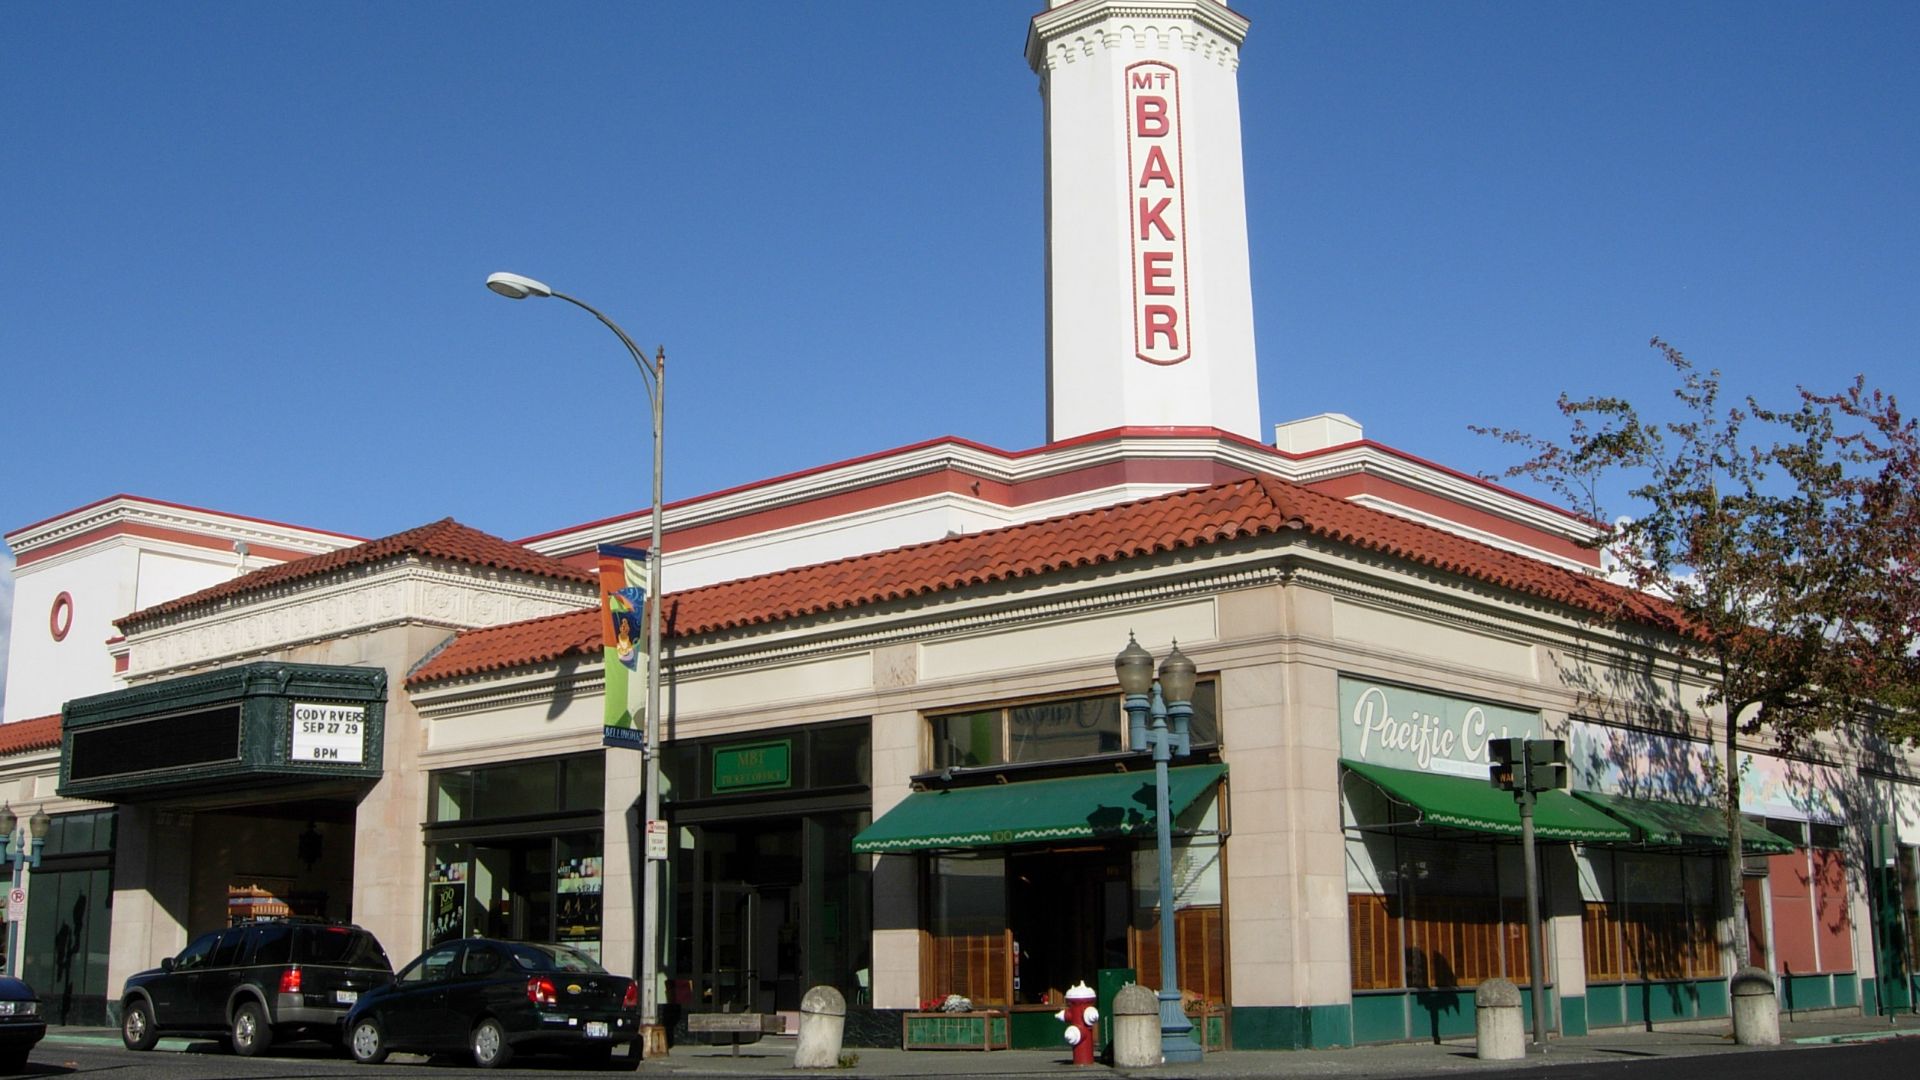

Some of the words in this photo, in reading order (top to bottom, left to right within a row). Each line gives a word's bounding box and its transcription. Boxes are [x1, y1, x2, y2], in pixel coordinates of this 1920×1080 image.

[1132, 72, 1170, 90] MT
[1135, 95, 1178, 350] BAKER
[296, 709, 327, 721] CODY
[303, 722, 325, 733] SEP
[327, 723, 340, 734] 27
[345, 723, 358, 735] 29
[1353, 687, 1455, 769] Pacific
[313, 747, 338, 759] 8PM
[992, 831, 1012, 843] 100
